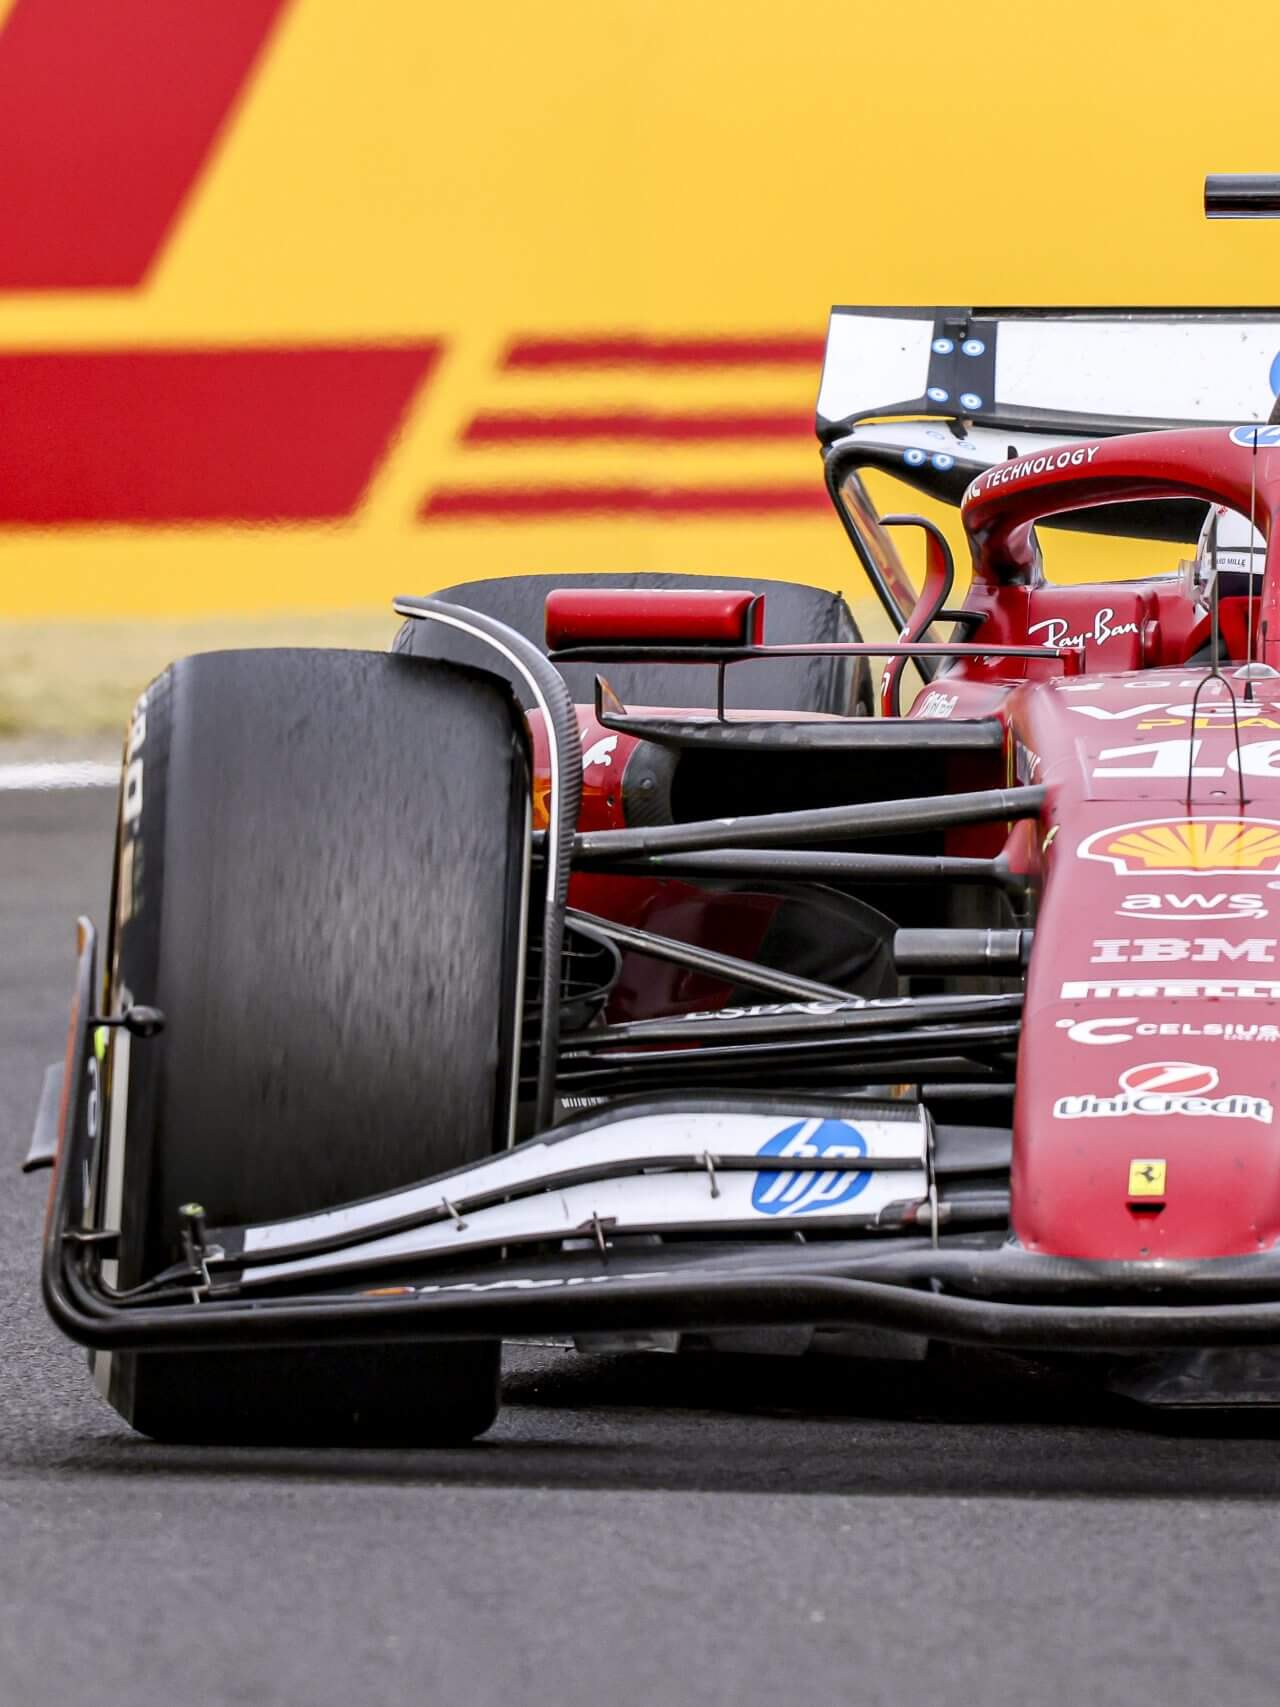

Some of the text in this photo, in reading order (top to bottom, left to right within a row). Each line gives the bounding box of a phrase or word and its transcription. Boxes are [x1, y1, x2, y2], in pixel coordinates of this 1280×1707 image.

[986, 446, 1099, 489] TECHNOLOGY
[1028, 608, 1139, 649] Ray-Ban
[1119, 892, 1266, 912] aws
[1089, 938, 1278, 963] IBM
[1136, 1023, 1280, 1037] CELSIUS
[1056, 1095, 1267, 1118] UniCredit
[760, 1117, 863, 1215] hp
